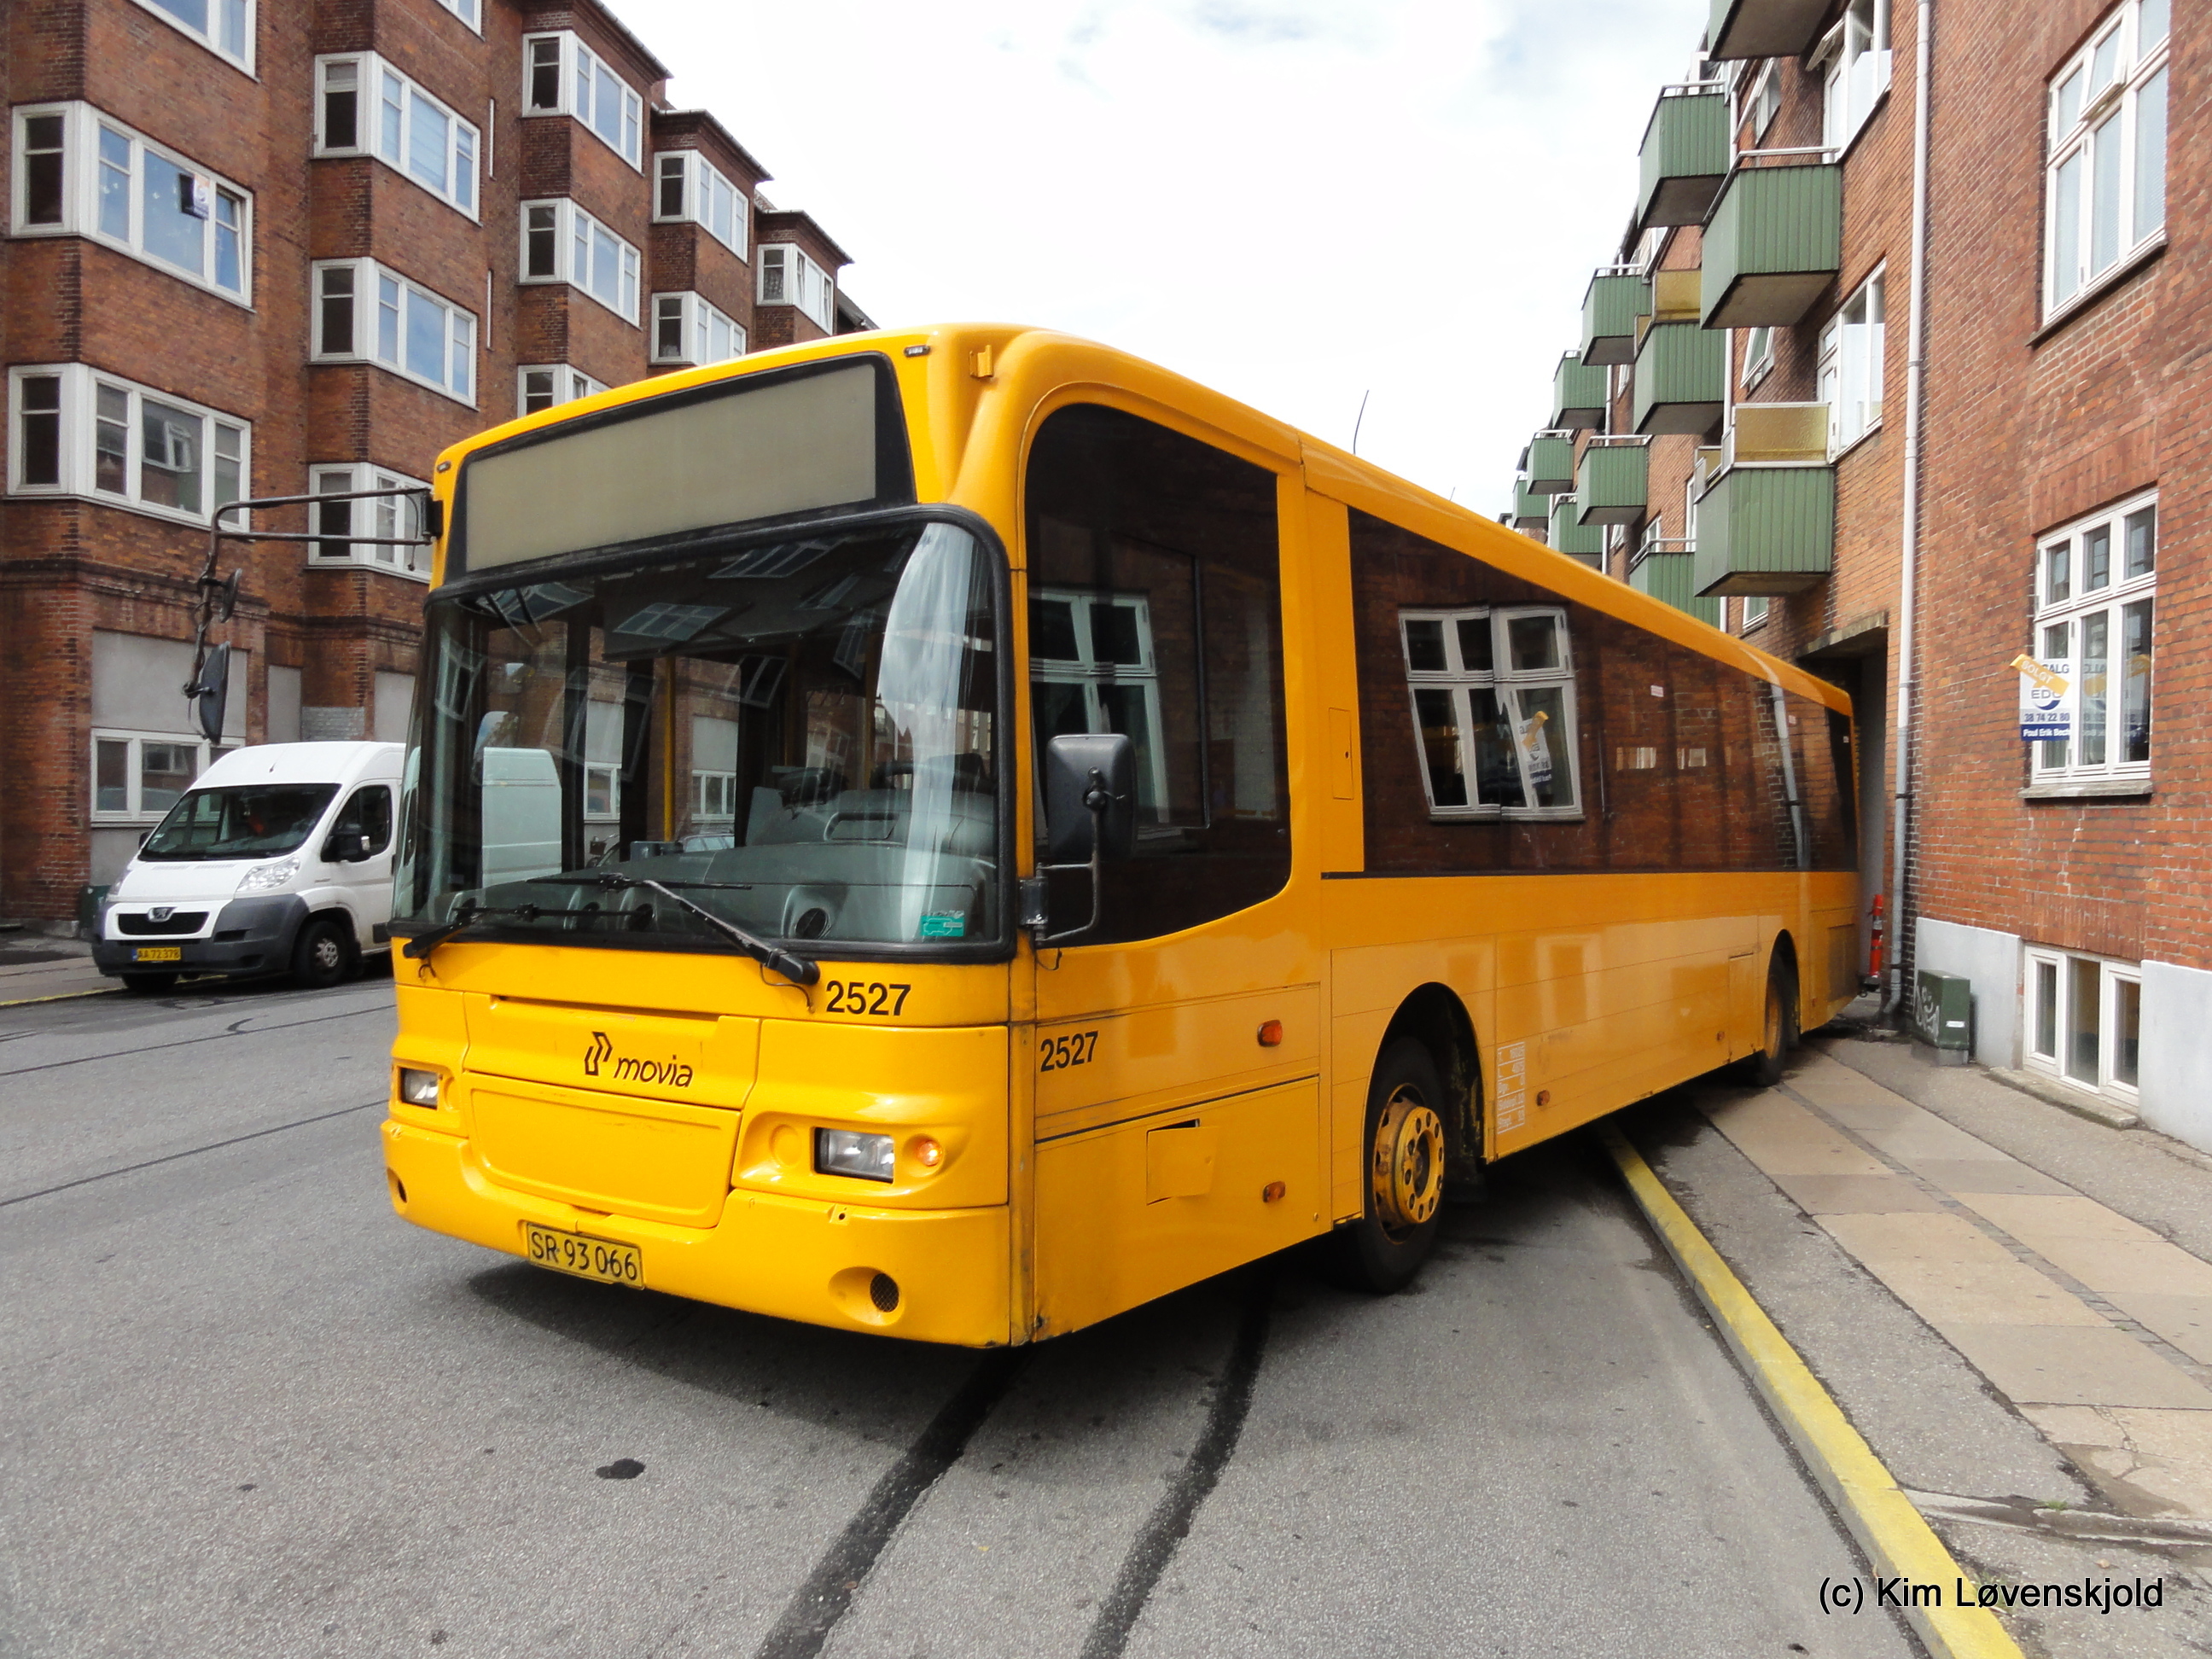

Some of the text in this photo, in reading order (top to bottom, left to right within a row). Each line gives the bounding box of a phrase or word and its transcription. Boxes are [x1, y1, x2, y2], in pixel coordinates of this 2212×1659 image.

[2022, 660, 2054, 684] SOLGT
[826, 980, 911, 1016] 2527
[1040, 1030, 1099, 1073] 2527
[613, 1054, 693, 1088] movia
[531, 1231, 637, 1281] SR 93 066
